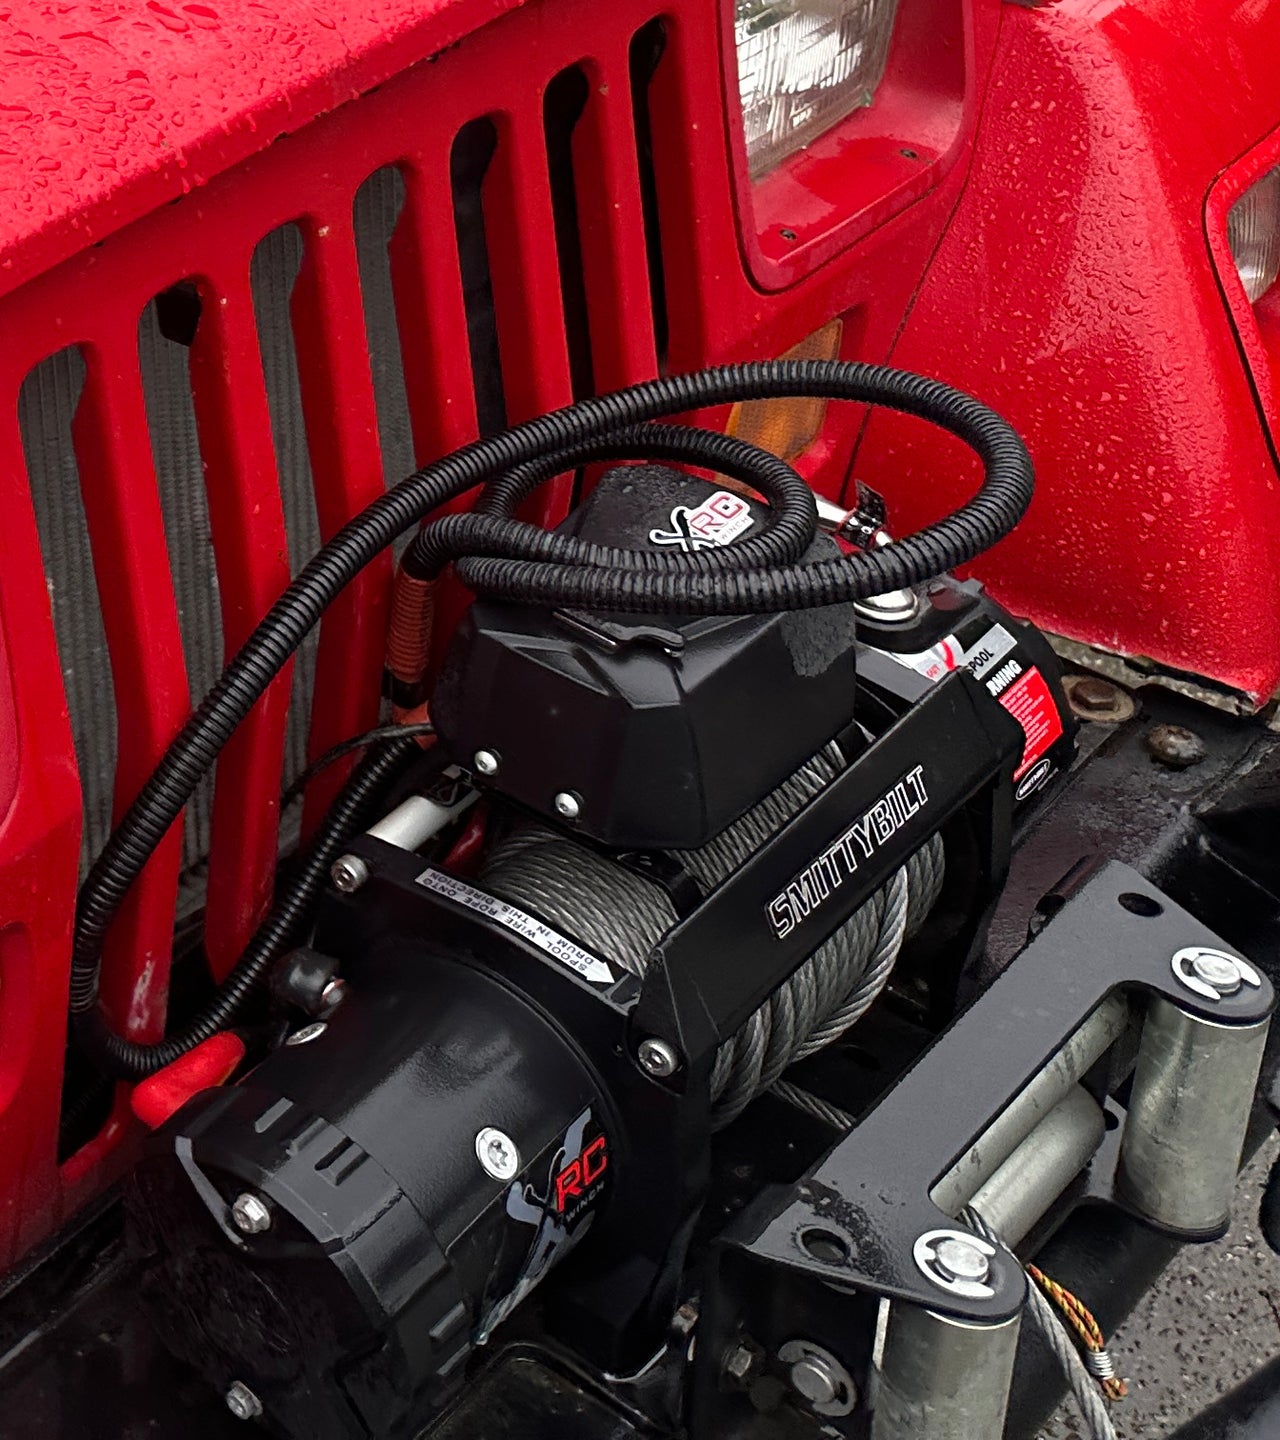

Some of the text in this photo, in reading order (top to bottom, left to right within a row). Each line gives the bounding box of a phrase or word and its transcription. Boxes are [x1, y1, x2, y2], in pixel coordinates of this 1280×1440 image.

[721, 516, 750, 540] WINCH
[768, 764, 930, 940] SMITTYBILT
[422, 877, 589, 972] SPOOL WIRE ROPE ONTO
[428, 871, 595, 966] DRUM IN THIS DIRECTION
[565, 1180, 606, 1222] WINCH
